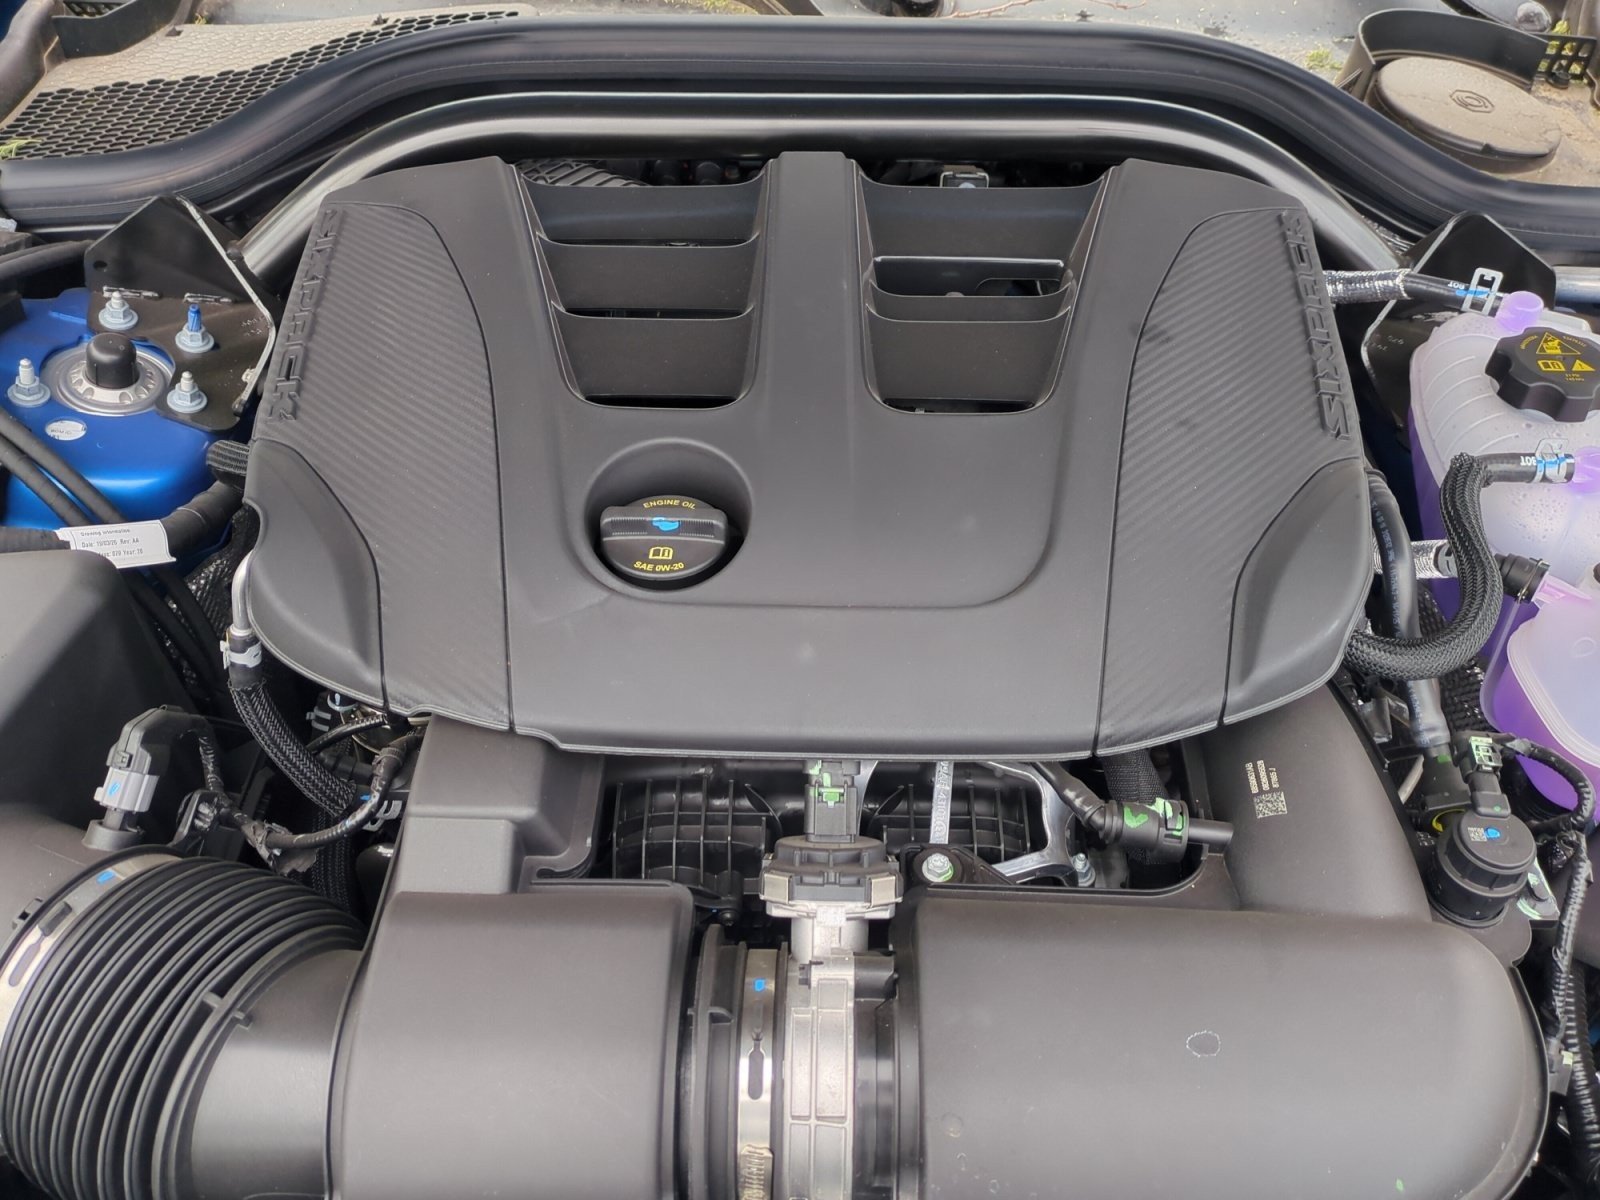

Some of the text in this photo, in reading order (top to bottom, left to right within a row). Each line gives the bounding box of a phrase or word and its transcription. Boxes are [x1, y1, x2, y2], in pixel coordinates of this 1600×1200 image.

[266, 208, 340, 421] SIXPACK
[1279, 211, 1350, 437] SIXPACK
[643, 499, 696, 510] ENGINE OIL
[633, 561, 685, 572] SAE 0W-20
